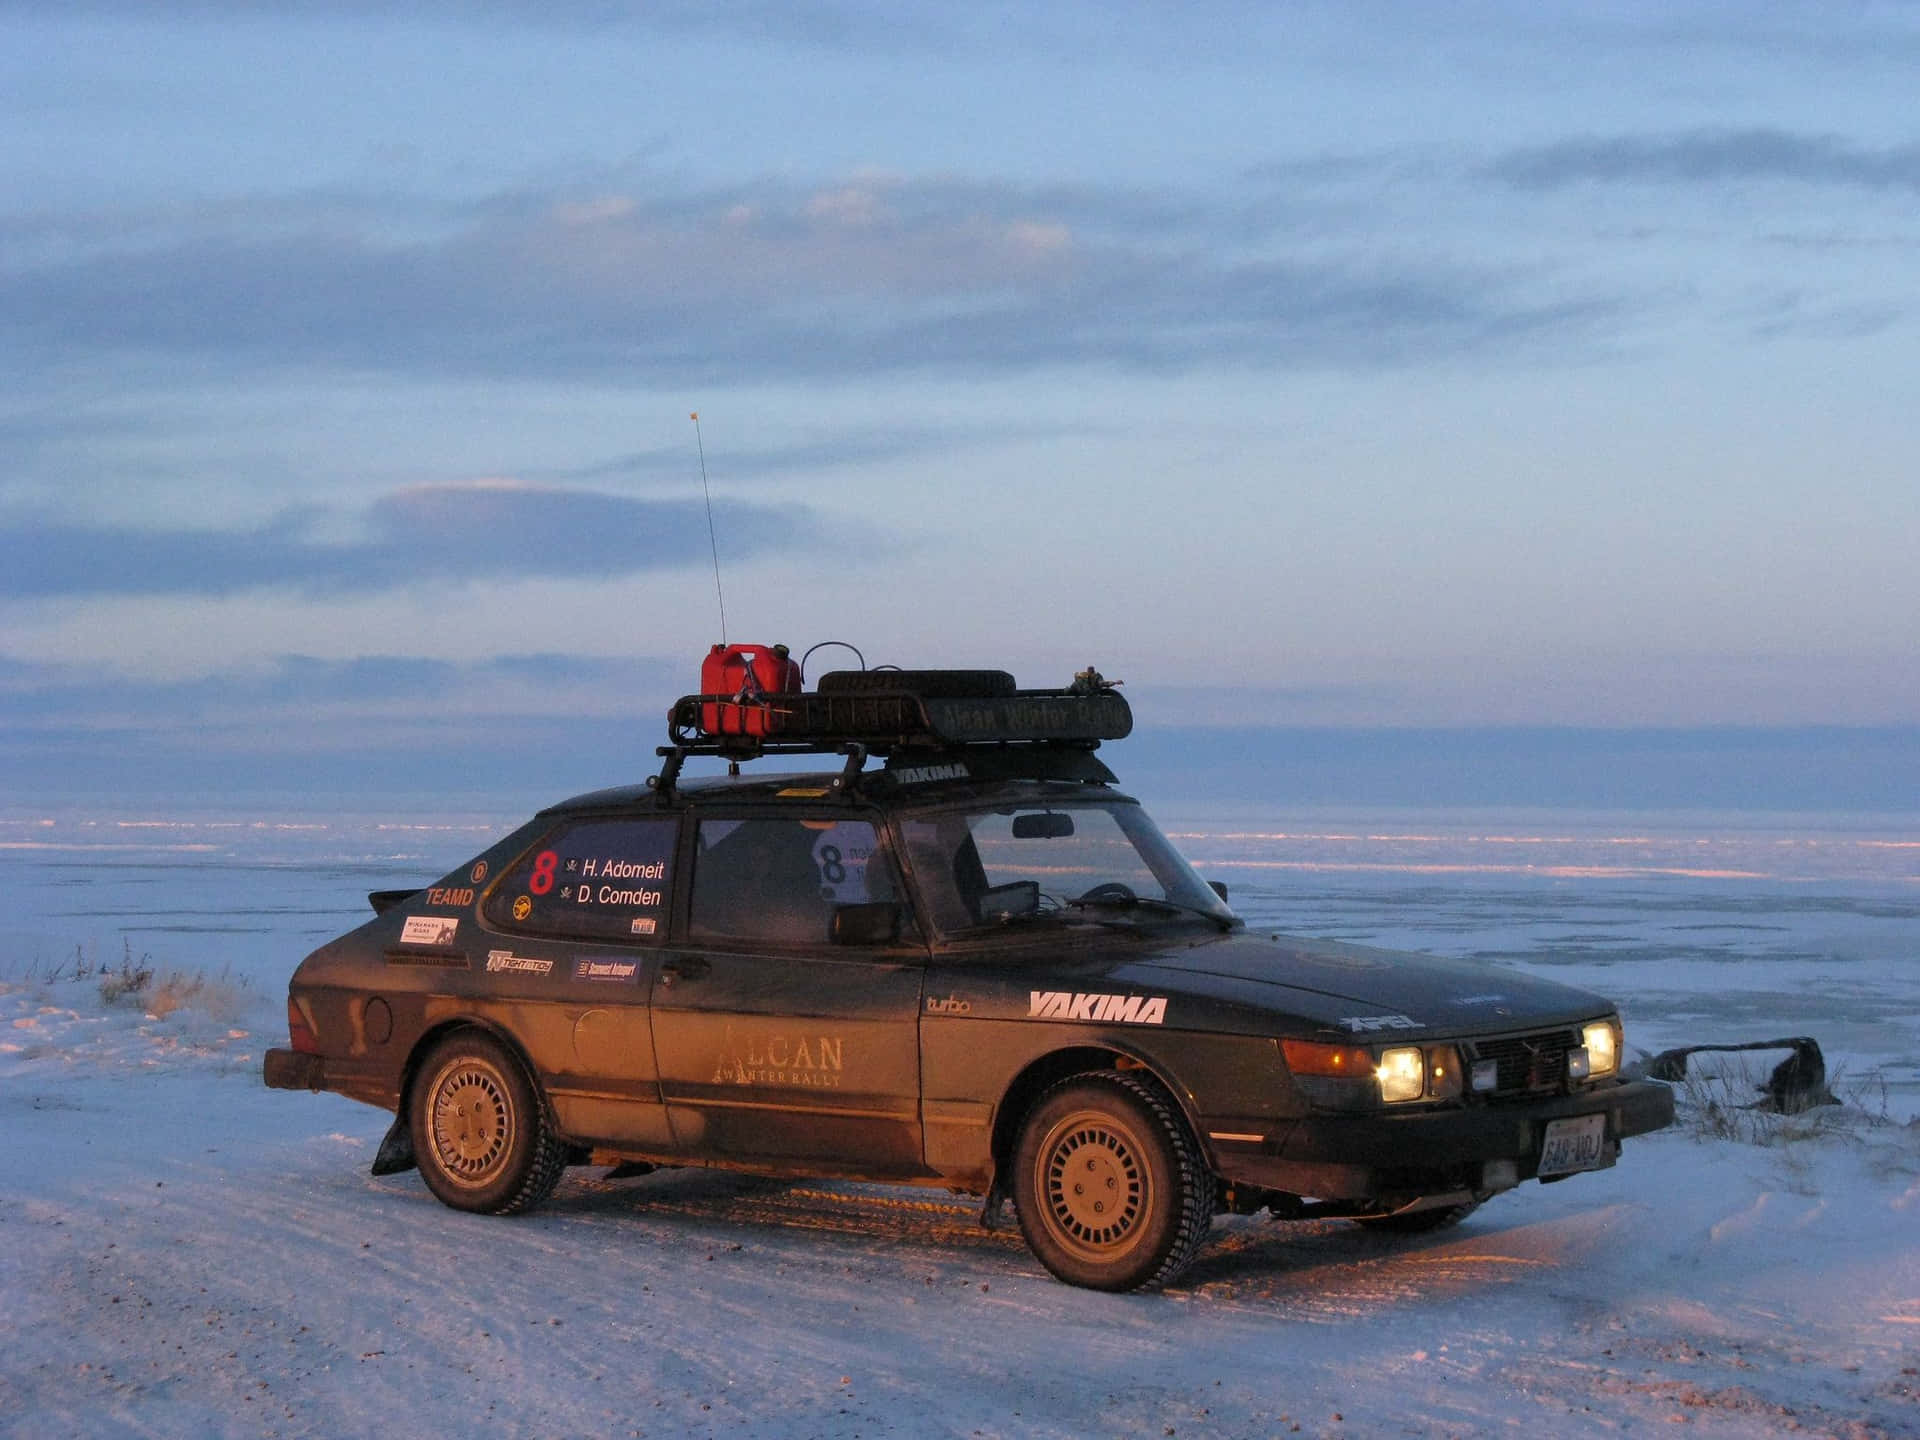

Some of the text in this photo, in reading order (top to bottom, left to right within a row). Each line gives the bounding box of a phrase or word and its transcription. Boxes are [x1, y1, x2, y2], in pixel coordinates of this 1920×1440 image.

[895, 763, 969, 785] YAKIMA
[528, 850, 559, 896] 8
[582, 859, 665, 880] H. Adomeit
[819, 844, 846, 884] 8
[425, 887, 475, 907] TEAMD
[577, 886, 662, 906] D. Comden
[1026, 991, 1169, 1025] YAKIMA
[791, 1071, 841, 1088] RALLY
